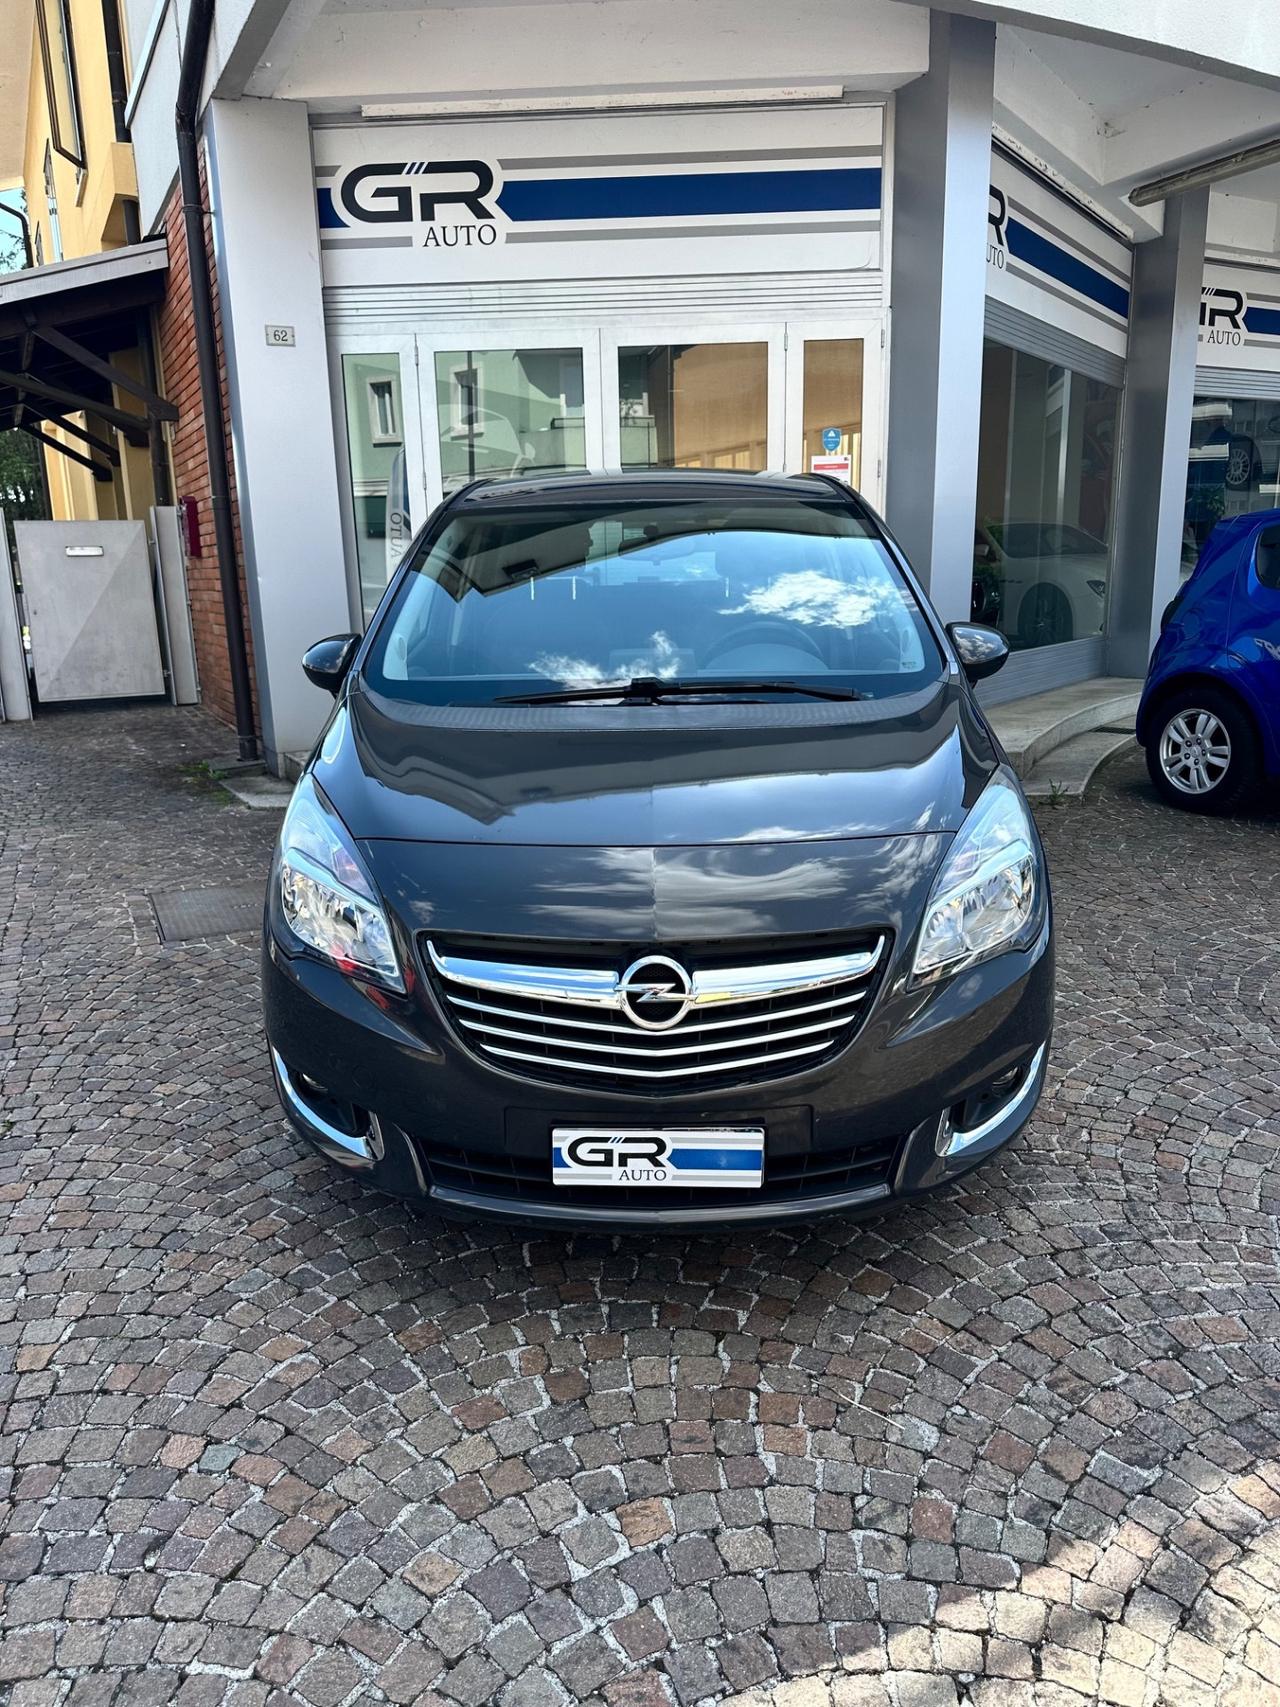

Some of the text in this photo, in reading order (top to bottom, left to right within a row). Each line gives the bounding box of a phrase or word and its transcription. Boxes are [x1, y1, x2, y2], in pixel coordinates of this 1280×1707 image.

[341, 160, 496, 223] GR
[987, 184, 1006, 247] R
[422, 224, 497, 247] AUTO
[986, 243, 1005, 269] UTO
[273, 329, 289, 342] 62
[1207, 329, 1241, 346] AUTO
[567, 1136, 667, 1168] GR
[618, 1169, 667, 1182] AUTO
